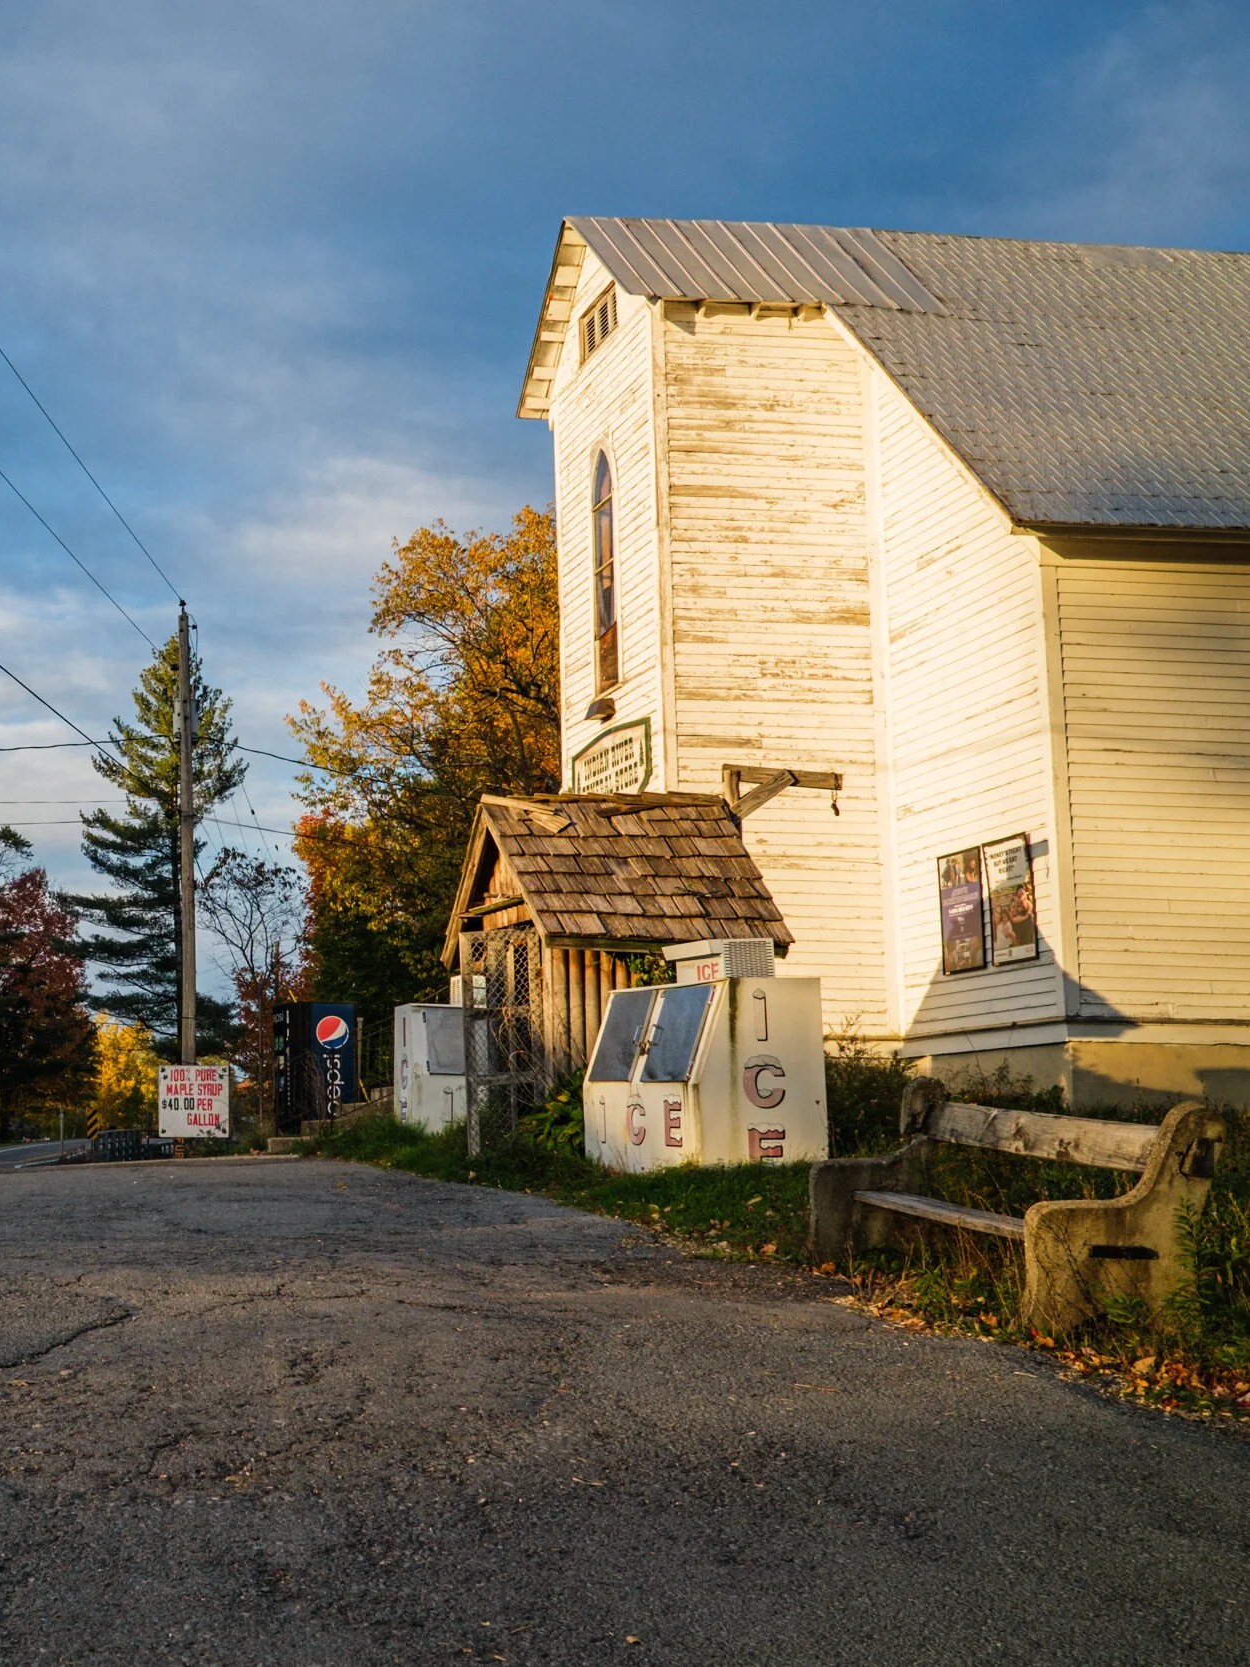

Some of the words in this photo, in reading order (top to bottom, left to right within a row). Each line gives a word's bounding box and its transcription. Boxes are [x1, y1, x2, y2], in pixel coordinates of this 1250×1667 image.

[611, 737, 635, 768] RIVER
[615, 761, 639, 792] STORE
[696, 962, 719, 981] ICE
[170, 1069, 191, 1082] 100%
[195, 1068, 217, 1081] PURE
[323, 1053, 344, 1116] pepsi
[742, 988, 786, 1163] ICE
[166, 1083, 194, 1096] MAPLE
[197, 1083, 223, 1096] SYRUP
[161, 1097, 195, 1111] $40.00
[197, 1098, 213, 1111] PER
[186, 1112, 220, 1126] GALLON
[598, 1093, 683, 1147] ICE
